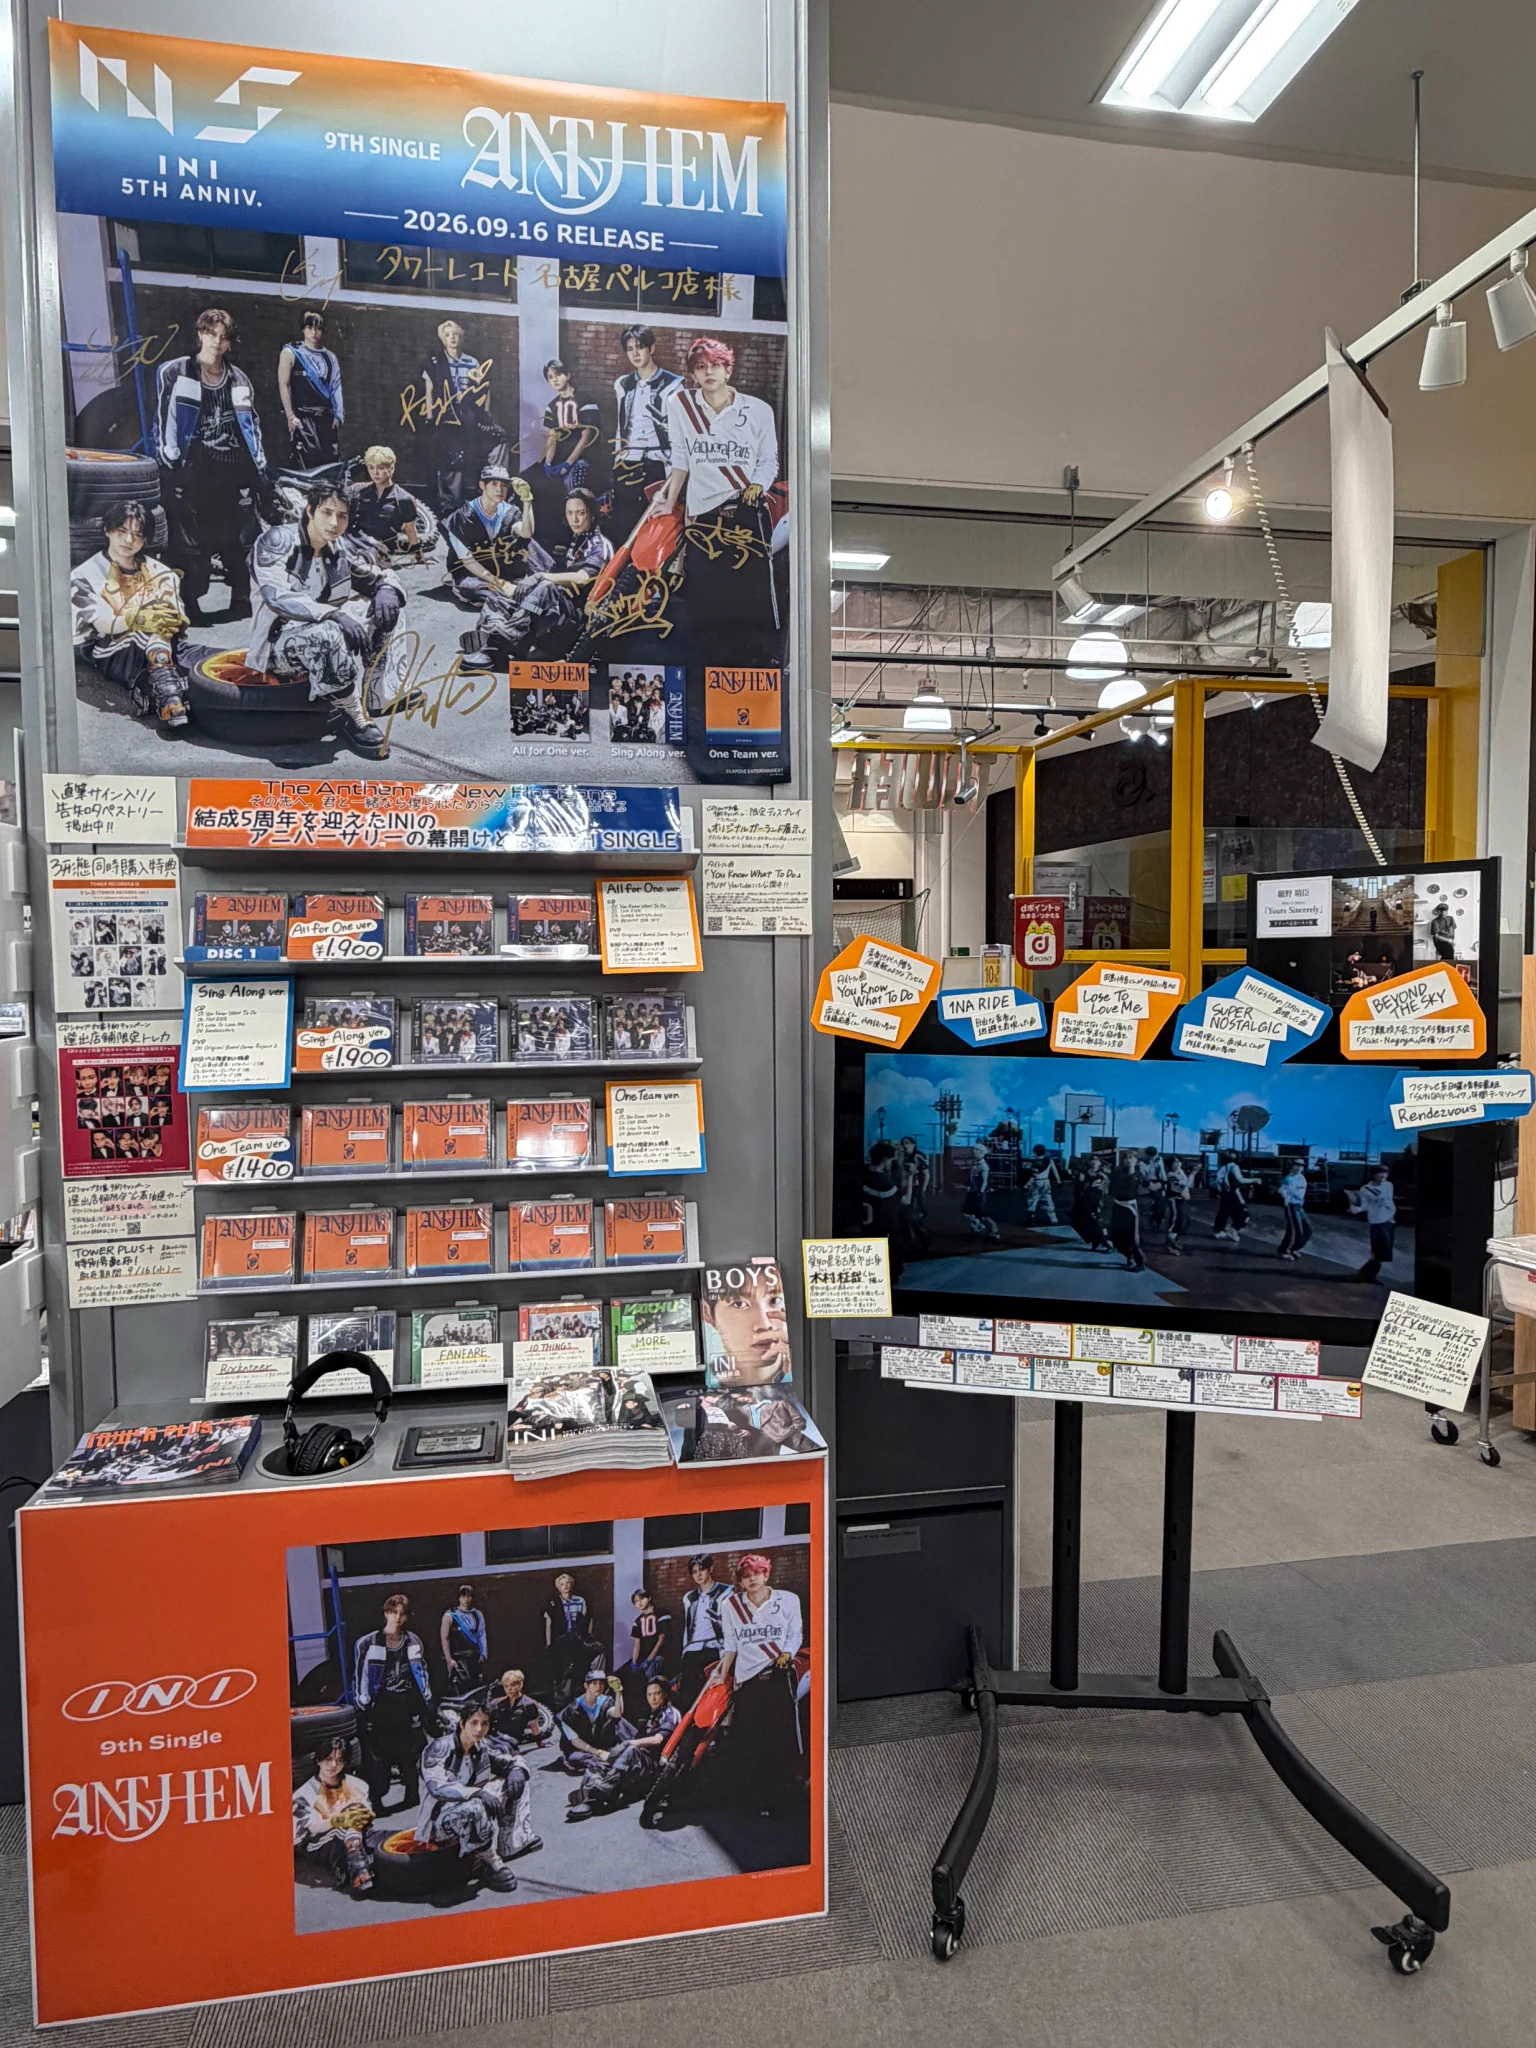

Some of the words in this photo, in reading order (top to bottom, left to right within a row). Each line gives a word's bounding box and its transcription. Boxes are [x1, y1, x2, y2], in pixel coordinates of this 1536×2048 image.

[324, 131, 364, 153] 9TH
[369, 135, 441, 161] SINGLE
[159, 154, 218, 180] INI
[460, 106, 764, 217] ANTHEM
[121, 177, 168, 199] 5TH
[179, 183, 263, 208] ANNIV.
[403, 208, 549, 242] 2026.09.16
[557, 223, 665, 252] RELEASE
[557, 400, 578, 426] 10
[735, 408, 748, 428] 5
[530, 664, 586, 684] ANTHEM
[708, 669, 778, 695] ANTHEM
[513, 746, 527, 756] All
[529, 746, 544, 756] for
[547, 747, 567, 757] One
[570, 748, 590, 757] ver.
[611, 748, 634, 760] Sing
[636, 748, 666, 760] Along
[667, 750, 687, 758] ver.
[708, 749, 729, 759] One
[731, 750, 758, 759] Team
[760, 751, 779, 760] ver.
[262, 780, 310, 795] The
[316, 781, 414, 796] Anthem
[453, 785, 506, 799] New
[250, 796, 314, 809] その先へ。
[194, 809, 437, 831] 結成5周年を迎えたINIの
[604, 832, 678, 849] SINGLE
[50, 856, 177, 877] 3形態同時購入特典
[728, 868, 749, 878] Know
[750, 868, 773, 878] What
[607, 883, 624, 894] All
[625, 883, 642, 893] for
[644, 882, 664, 893] One
[1020, 903, 1061, 912] dポイントが
[291, 924, 312, 936] All
[313, 922, 329, 935] for
[332, 921, 353, 934] One
[356, 922, 375, 931] ver.
[207, 948, 243, 959] DISC
[249, 948, 257, 959] 1
[199, 985, 226, 999] Sing
[230, 984, 266, 999] Along
[837, 985, 857, 998] You
[860, 982, 888, 996] Know
[853, 993, 882, 1008] What
[885, 990, 898, 1003] To
[900, 989, 914, 1001] Do
[1083, 990, 1111, 1003] Lose
[1113, 989, 1129, 1001] To
[1372, 983, 1427, 1013] BEYOND
[978, 995, 1010, 1009] RIDE
[1091, 1002, 1119, 1015] Love
[1121, 1000, 1143, 1014] Me
[1390, 1000, 1420, 1019] THE
[1421, 989, 1446, 1010] SKY
[1211, 1003, 1254, 1021] SUPER
[1209, 1016, 1283, 1035] NOSTALGIC
[300, 1033, 327, 1046] Sing
[332, 1030, 365, 1044] Along
[368, 1029, 387, 1038] ver.
[615, 1088, 638, 1102] One
[638, 1088, 662, 1101] Team
[315, 1108, 385, 1130] ANTHEM
[416, 1103, 487, 1126] ANTHEM
[1397, 1104, 1477, 1124] Rendezvous
[201, 1143, 228, 1158] One
[230, 1141, 263, 1154] Team
[266, 1139, 288, 1150] ver.
[219, 1218, 290, 1241] ANTHEM
[318, 1214, 387, 1236] ANTHEM
[72, 1246, 115, 1258] TOWER
[117, 1244, 155, 1255] PLUS+
[705, 1266, 778, 1291] BOYS
[1384, 1311, 1419, 1330] CITY
[1417, 1322, 1429, 1332] OF
[1429, 1325, 1481, 1348] LIGHTS
[540, 1341, 572, 1352] THINGS
[635, 1335, 667, 1346] MORE
[439, 1346, 487, 1360] FANFARE
[713, 1356, 737, 1373] INI
[514, 1427, 556, 1446] INI
[640, 1615, 657, 1638] 10
[87, 1676, 231, 1715] INI
[100, 1737, 142, 1756] 9th
[148, 1729, 223, 1751] Single
[51, 1761, 274, 1843] ANTHEM
